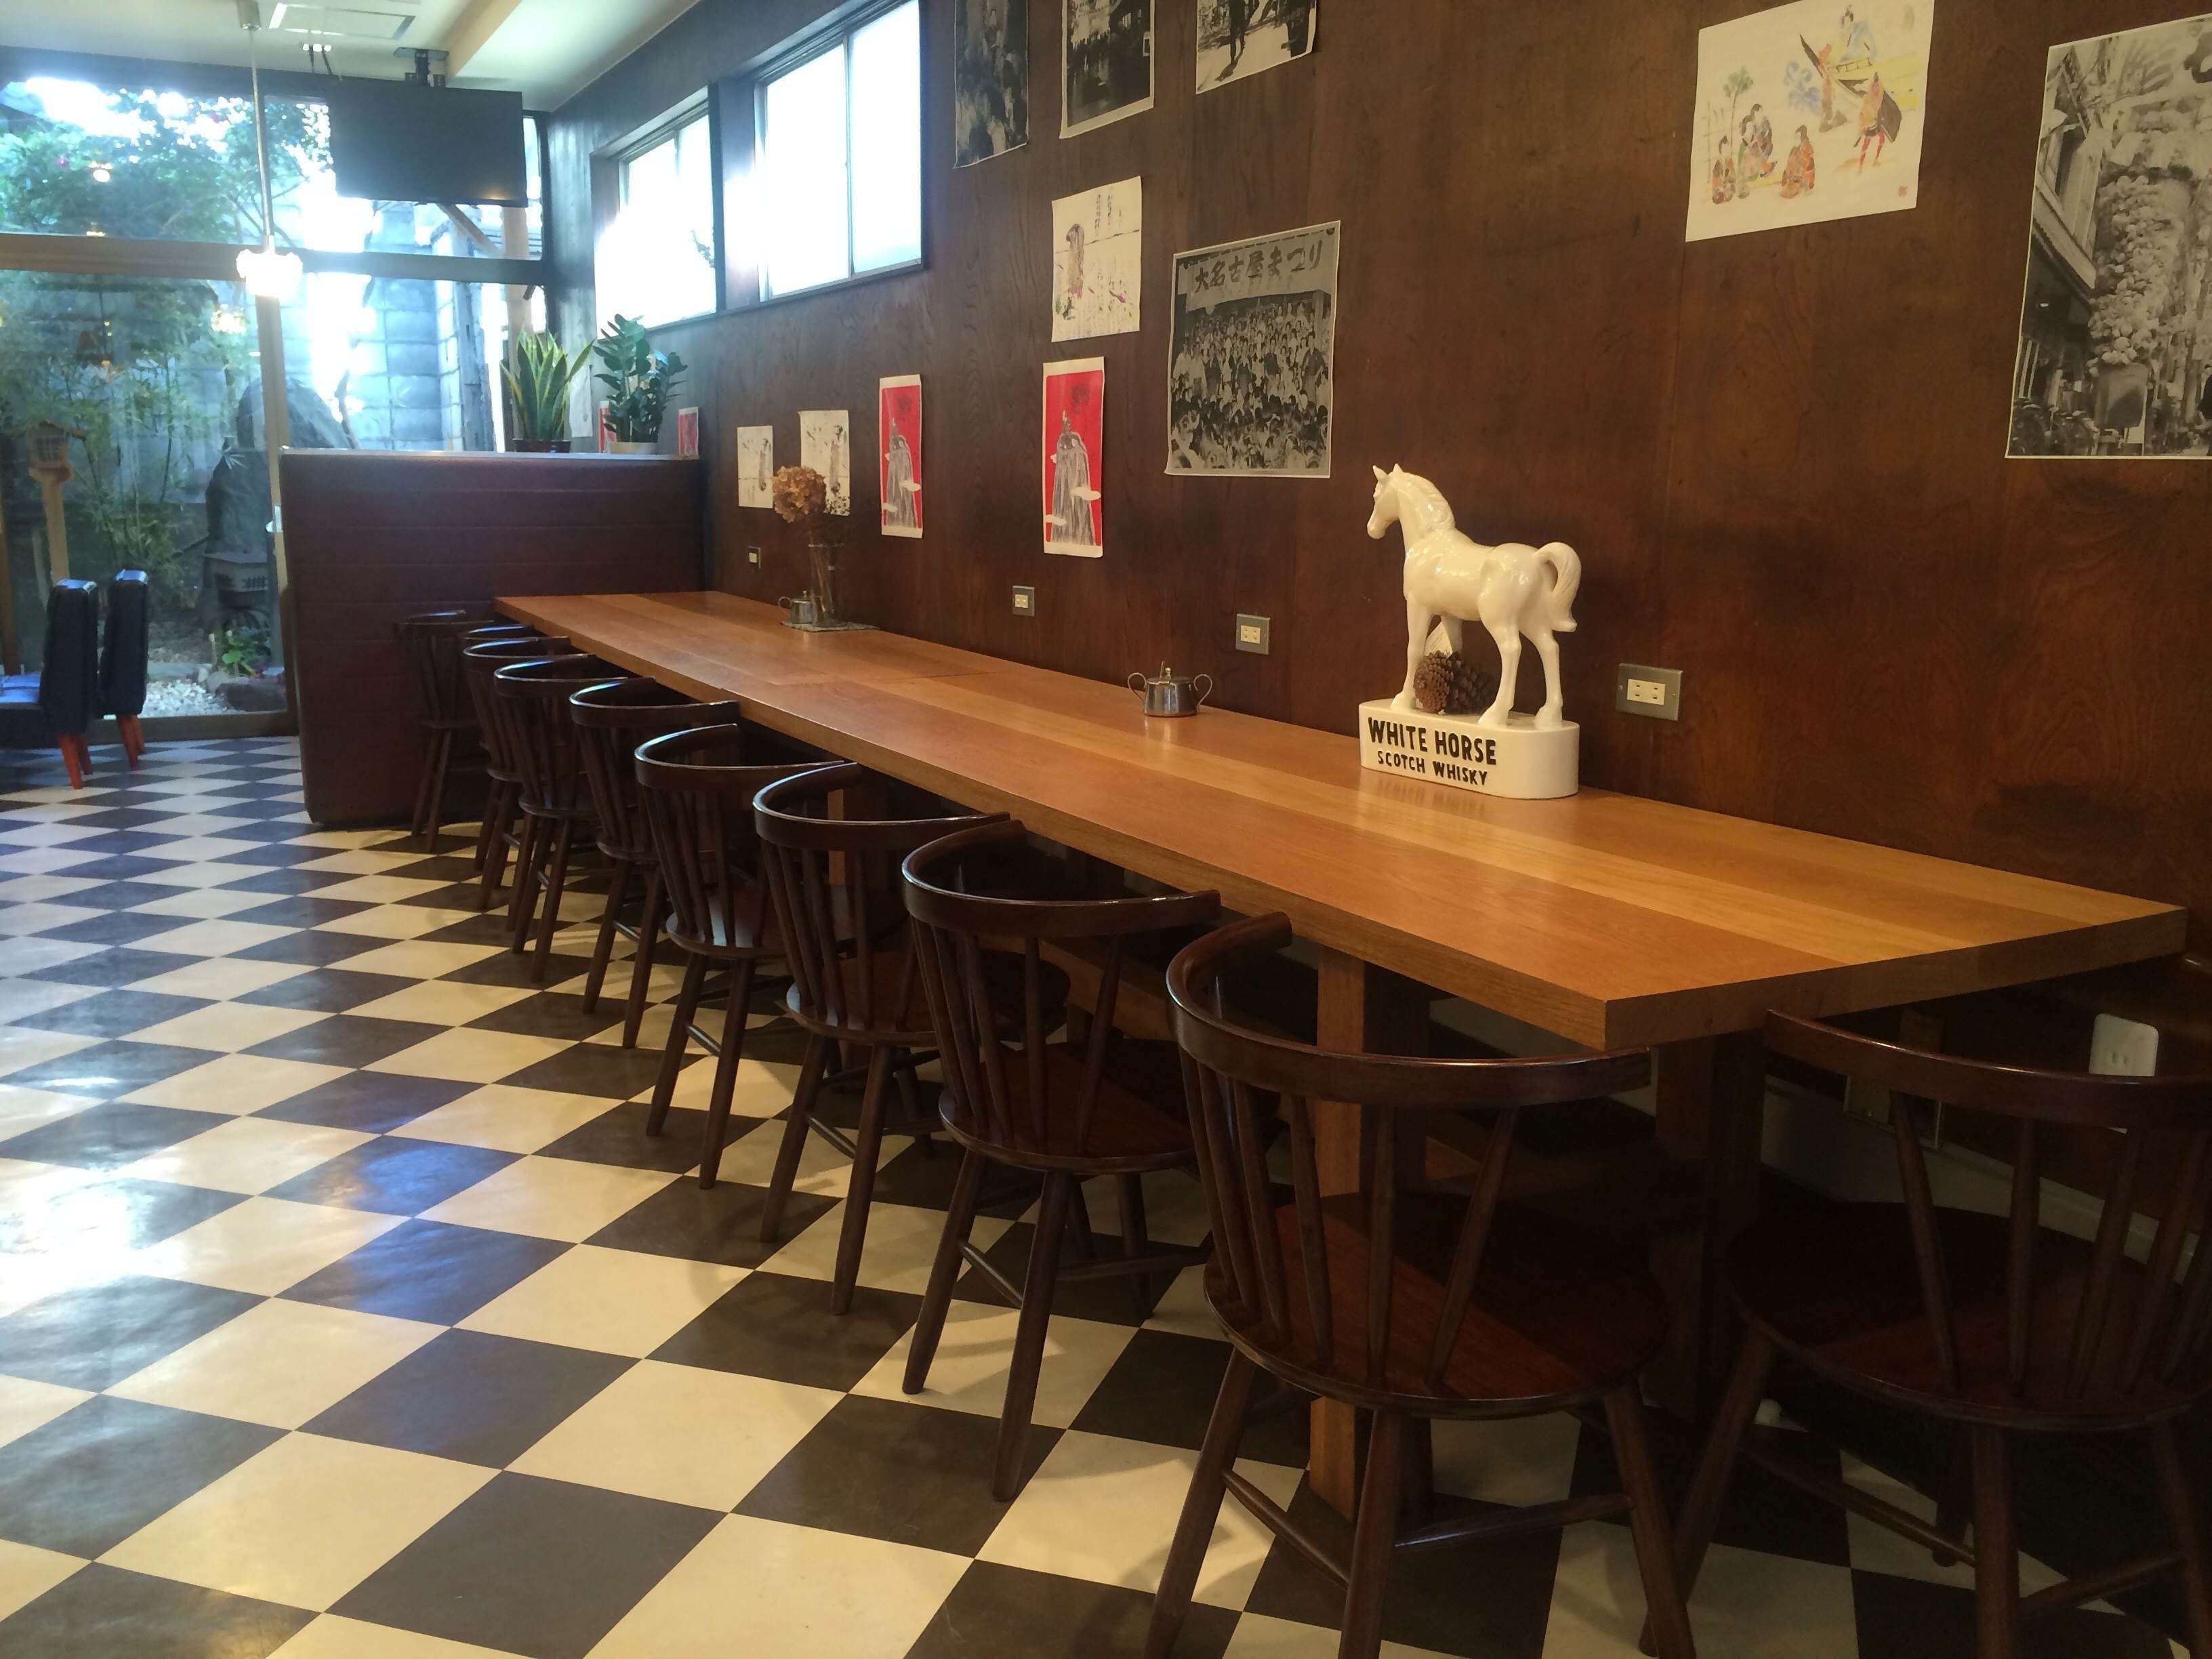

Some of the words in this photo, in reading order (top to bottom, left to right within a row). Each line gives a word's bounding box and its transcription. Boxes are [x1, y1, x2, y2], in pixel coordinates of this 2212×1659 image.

[1368, 717, 1427, 752] WHITE
[1435, 730, 1496, 765] HORSE
[1378, 751, 1426, 773] SCOTCH
[1433, 761, 1488, 785] WHISKY
